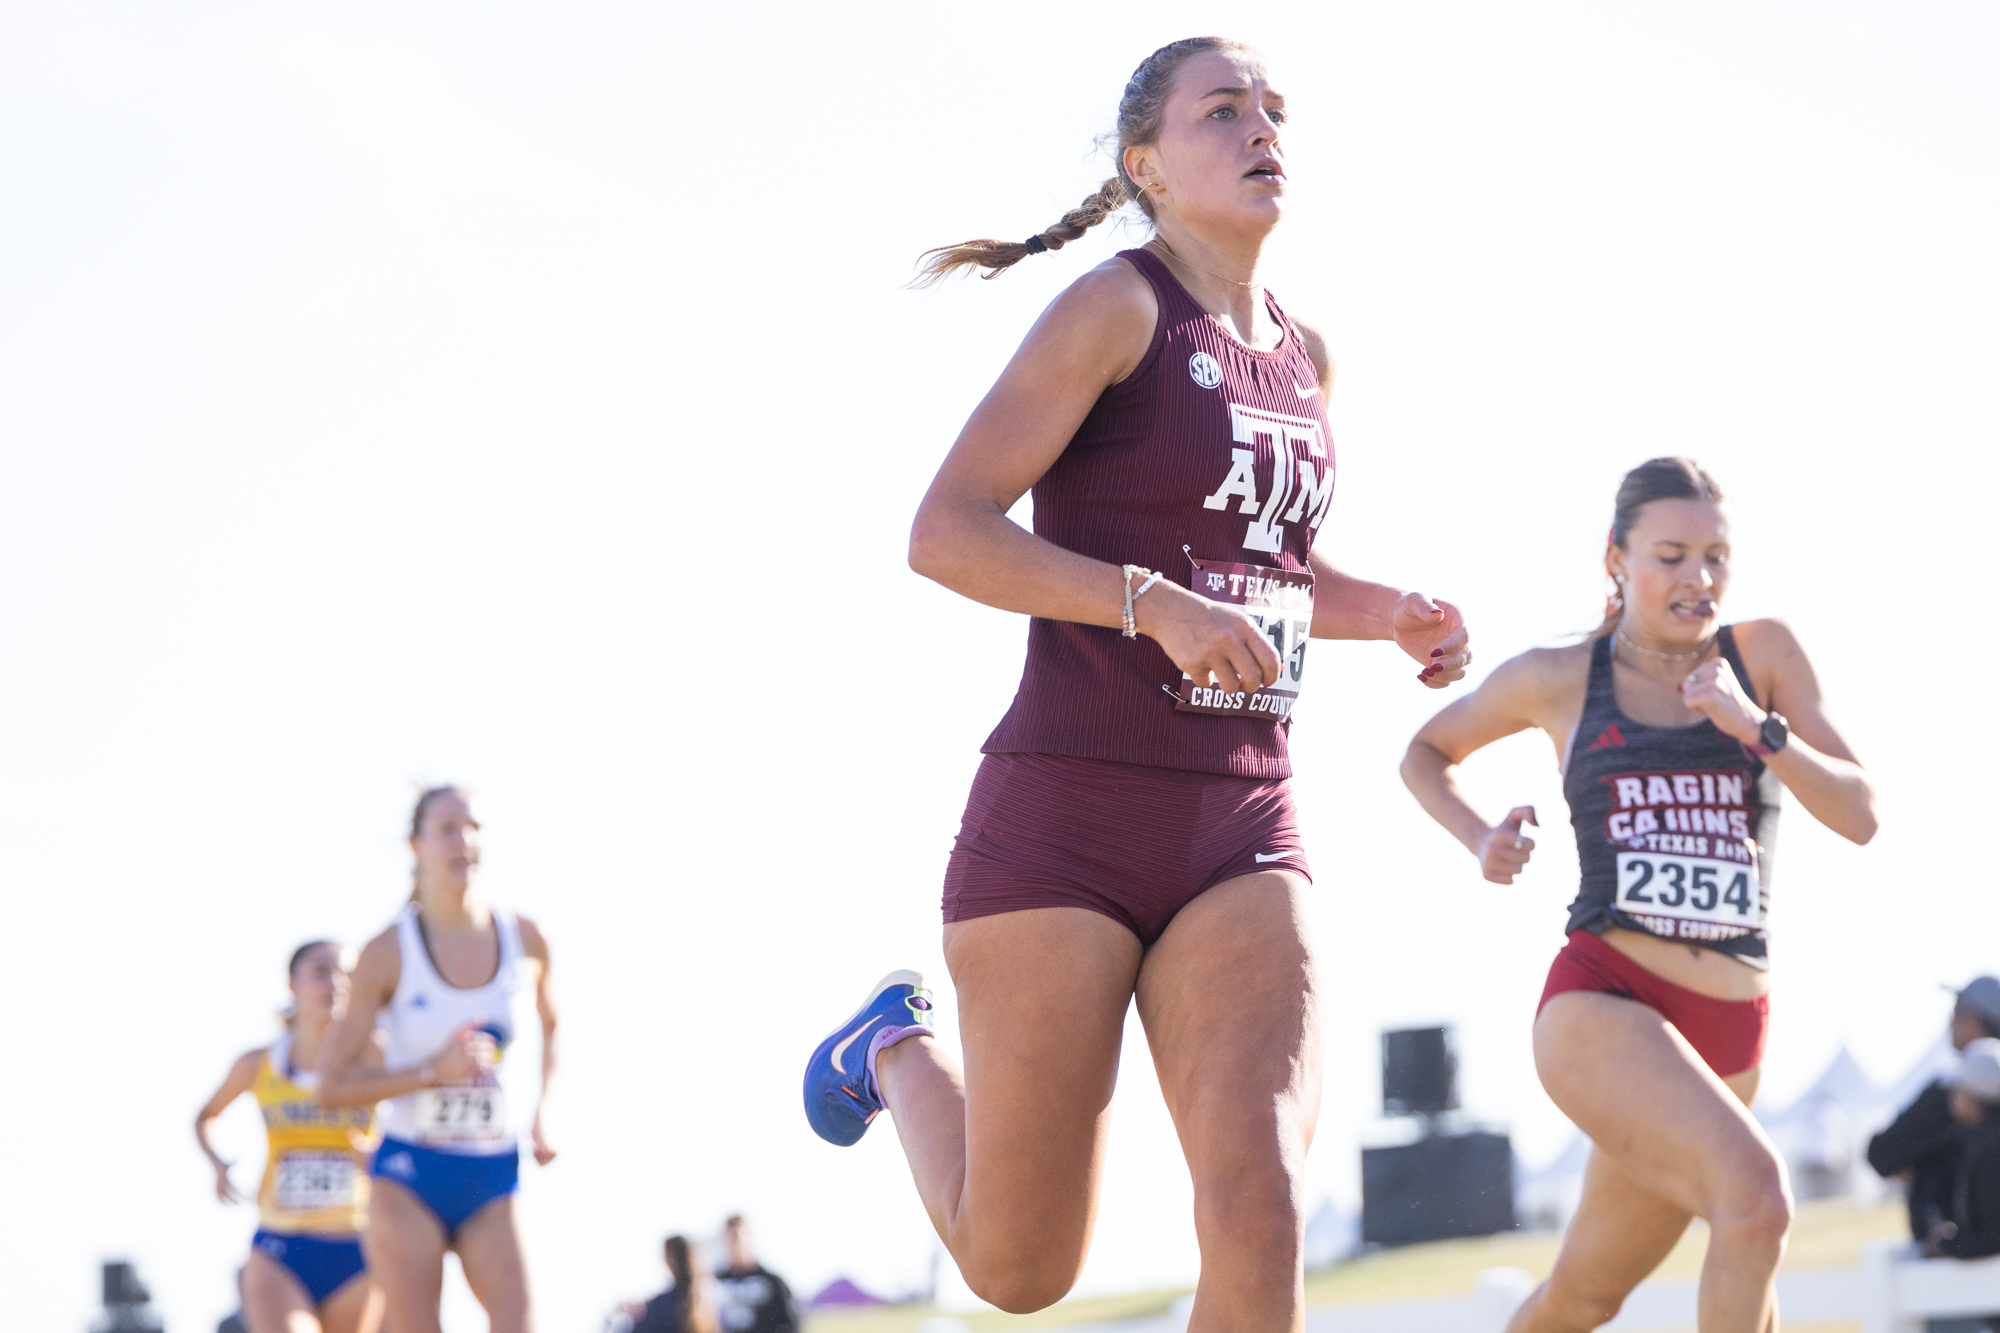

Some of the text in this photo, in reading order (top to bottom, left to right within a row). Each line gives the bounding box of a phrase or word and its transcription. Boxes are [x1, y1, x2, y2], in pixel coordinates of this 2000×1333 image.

[1228, 574, 1281, 600] TEXAS
[1248, 613, 1308, 682] 15
[1191, 687, 1245, 709] CROSS
[1645, 833, 1708, 856] TEXAS
[1715, 839, 1750, 863] A&M
[1625, 860, 1751, 915] 2354
